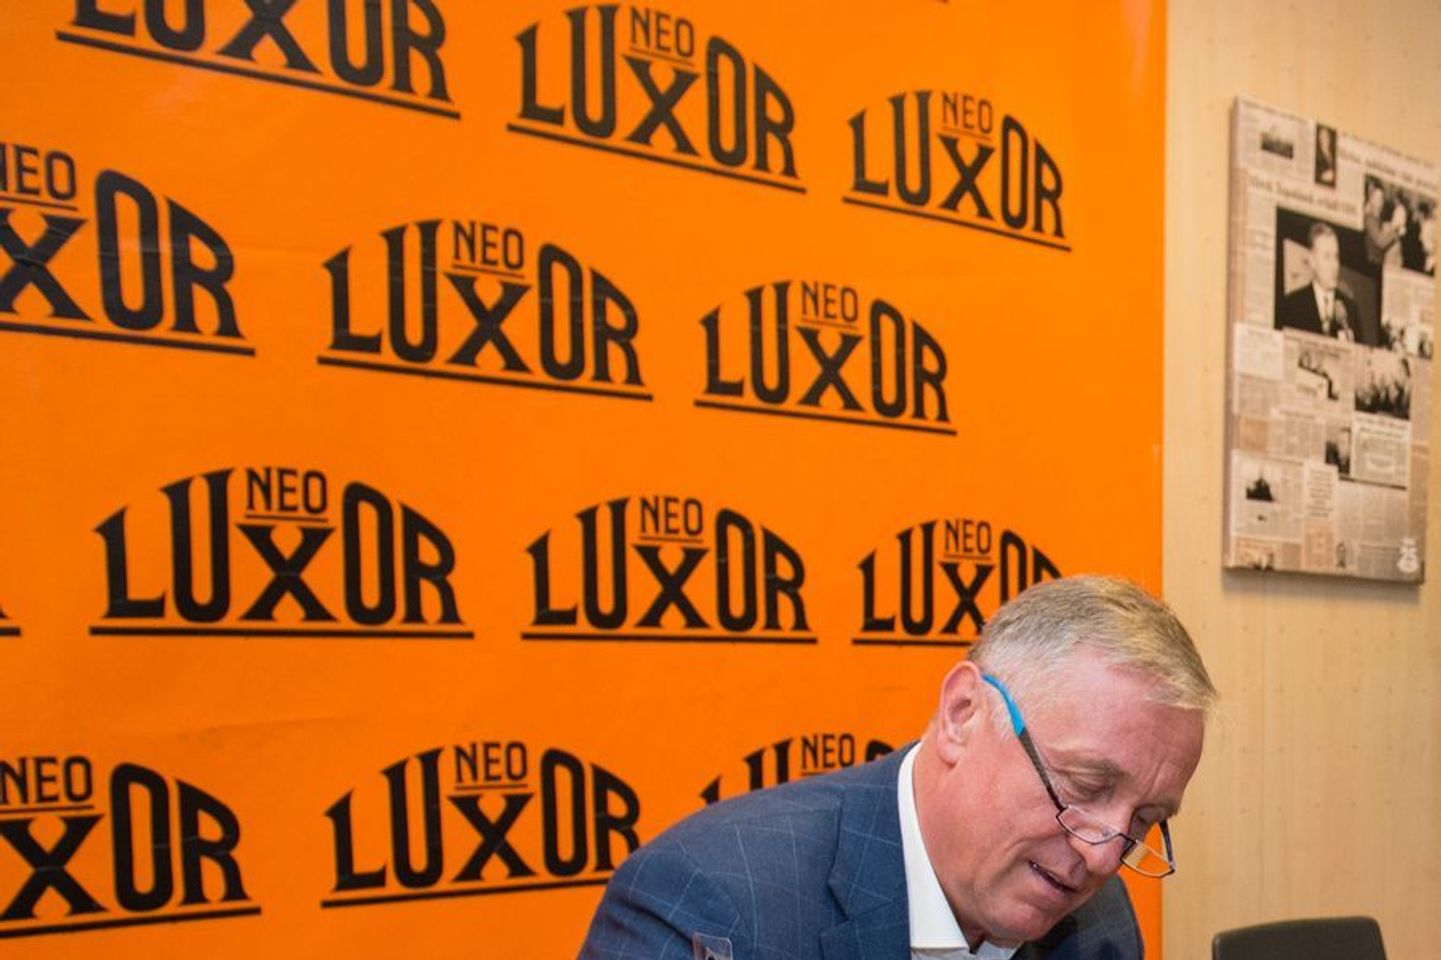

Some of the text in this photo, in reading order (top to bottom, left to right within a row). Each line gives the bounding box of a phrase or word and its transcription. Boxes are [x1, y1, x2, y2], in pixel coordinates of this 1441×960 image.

[630, 7, 695, 58] NEO
[515, 4, 797, 178] LUXOR
[941, 91, 994, 135] NEO
[848, 91, 1065, 239] LUXOR
[452, 221, 525, 271] NEO
[323, 219, 646, 386] LUXOR
[801, 281, 859, 323] NEO
[700, 281, 950, 423] LUXOR
[245, 467, 329, 516] NEO
[640, 496, 704, 538] NEO
[94, 467, 465, 627] LUXOR
[945, 519, 992, 555] NEO
[526, 497, 810, 633] LUXOR
[454, 741, 528, 784] NEO
[800, 734, 856, 771] NEO
[0, 755, 94, 807] NEO
[324, 747, 641, 892] LUXOR
